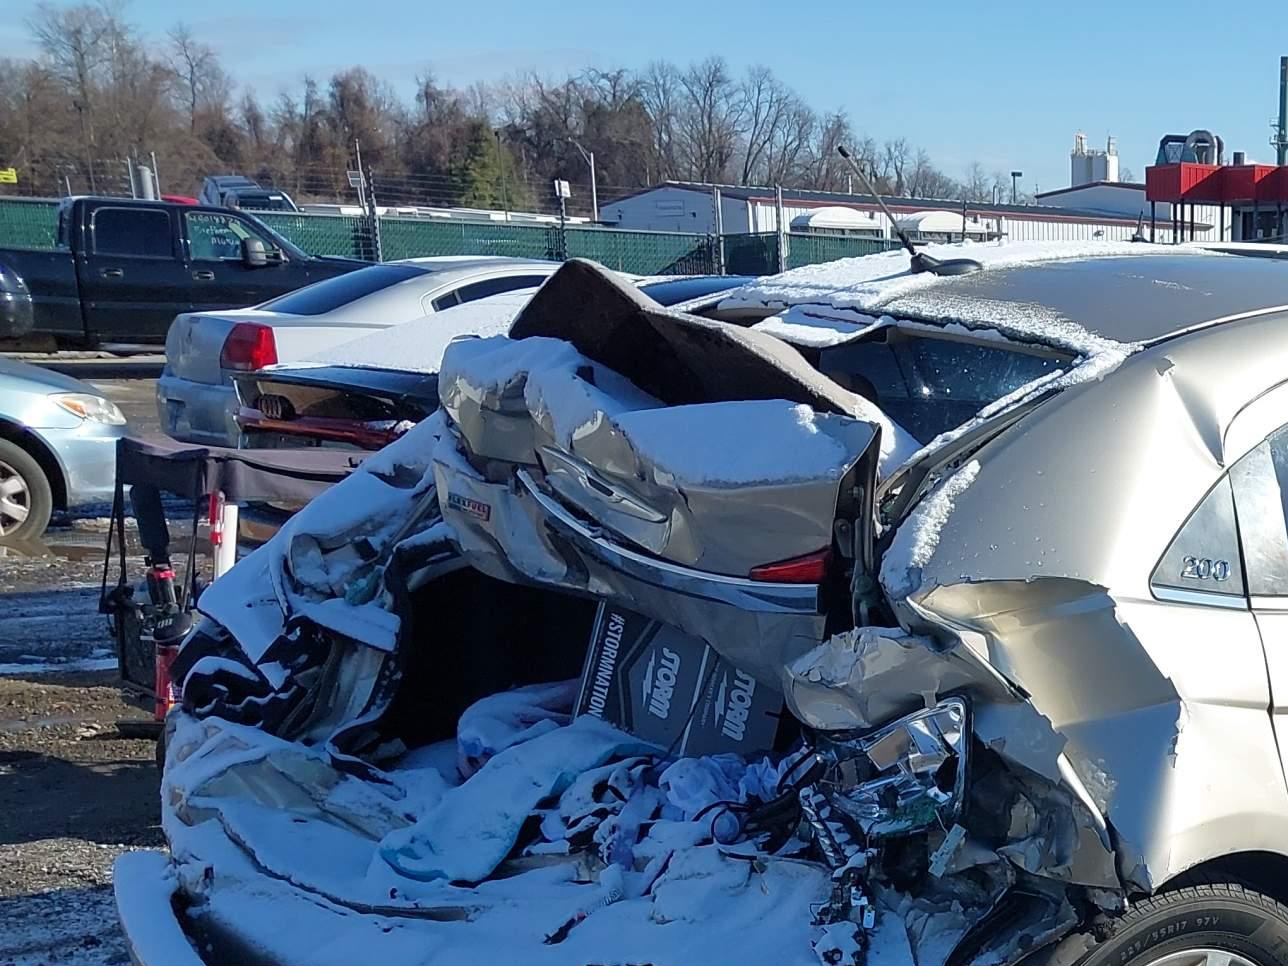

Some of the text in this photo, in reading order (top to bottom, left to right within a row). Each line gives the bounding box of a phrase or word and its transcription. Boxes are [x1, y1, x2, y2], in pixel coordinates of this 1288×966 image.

[1181, 555, 1232, 581] 200
[587, 612, 626, 717] #STORMNATION
[648, 646, 681, 720] STORM
[721, 667, 756, 742] STORM
